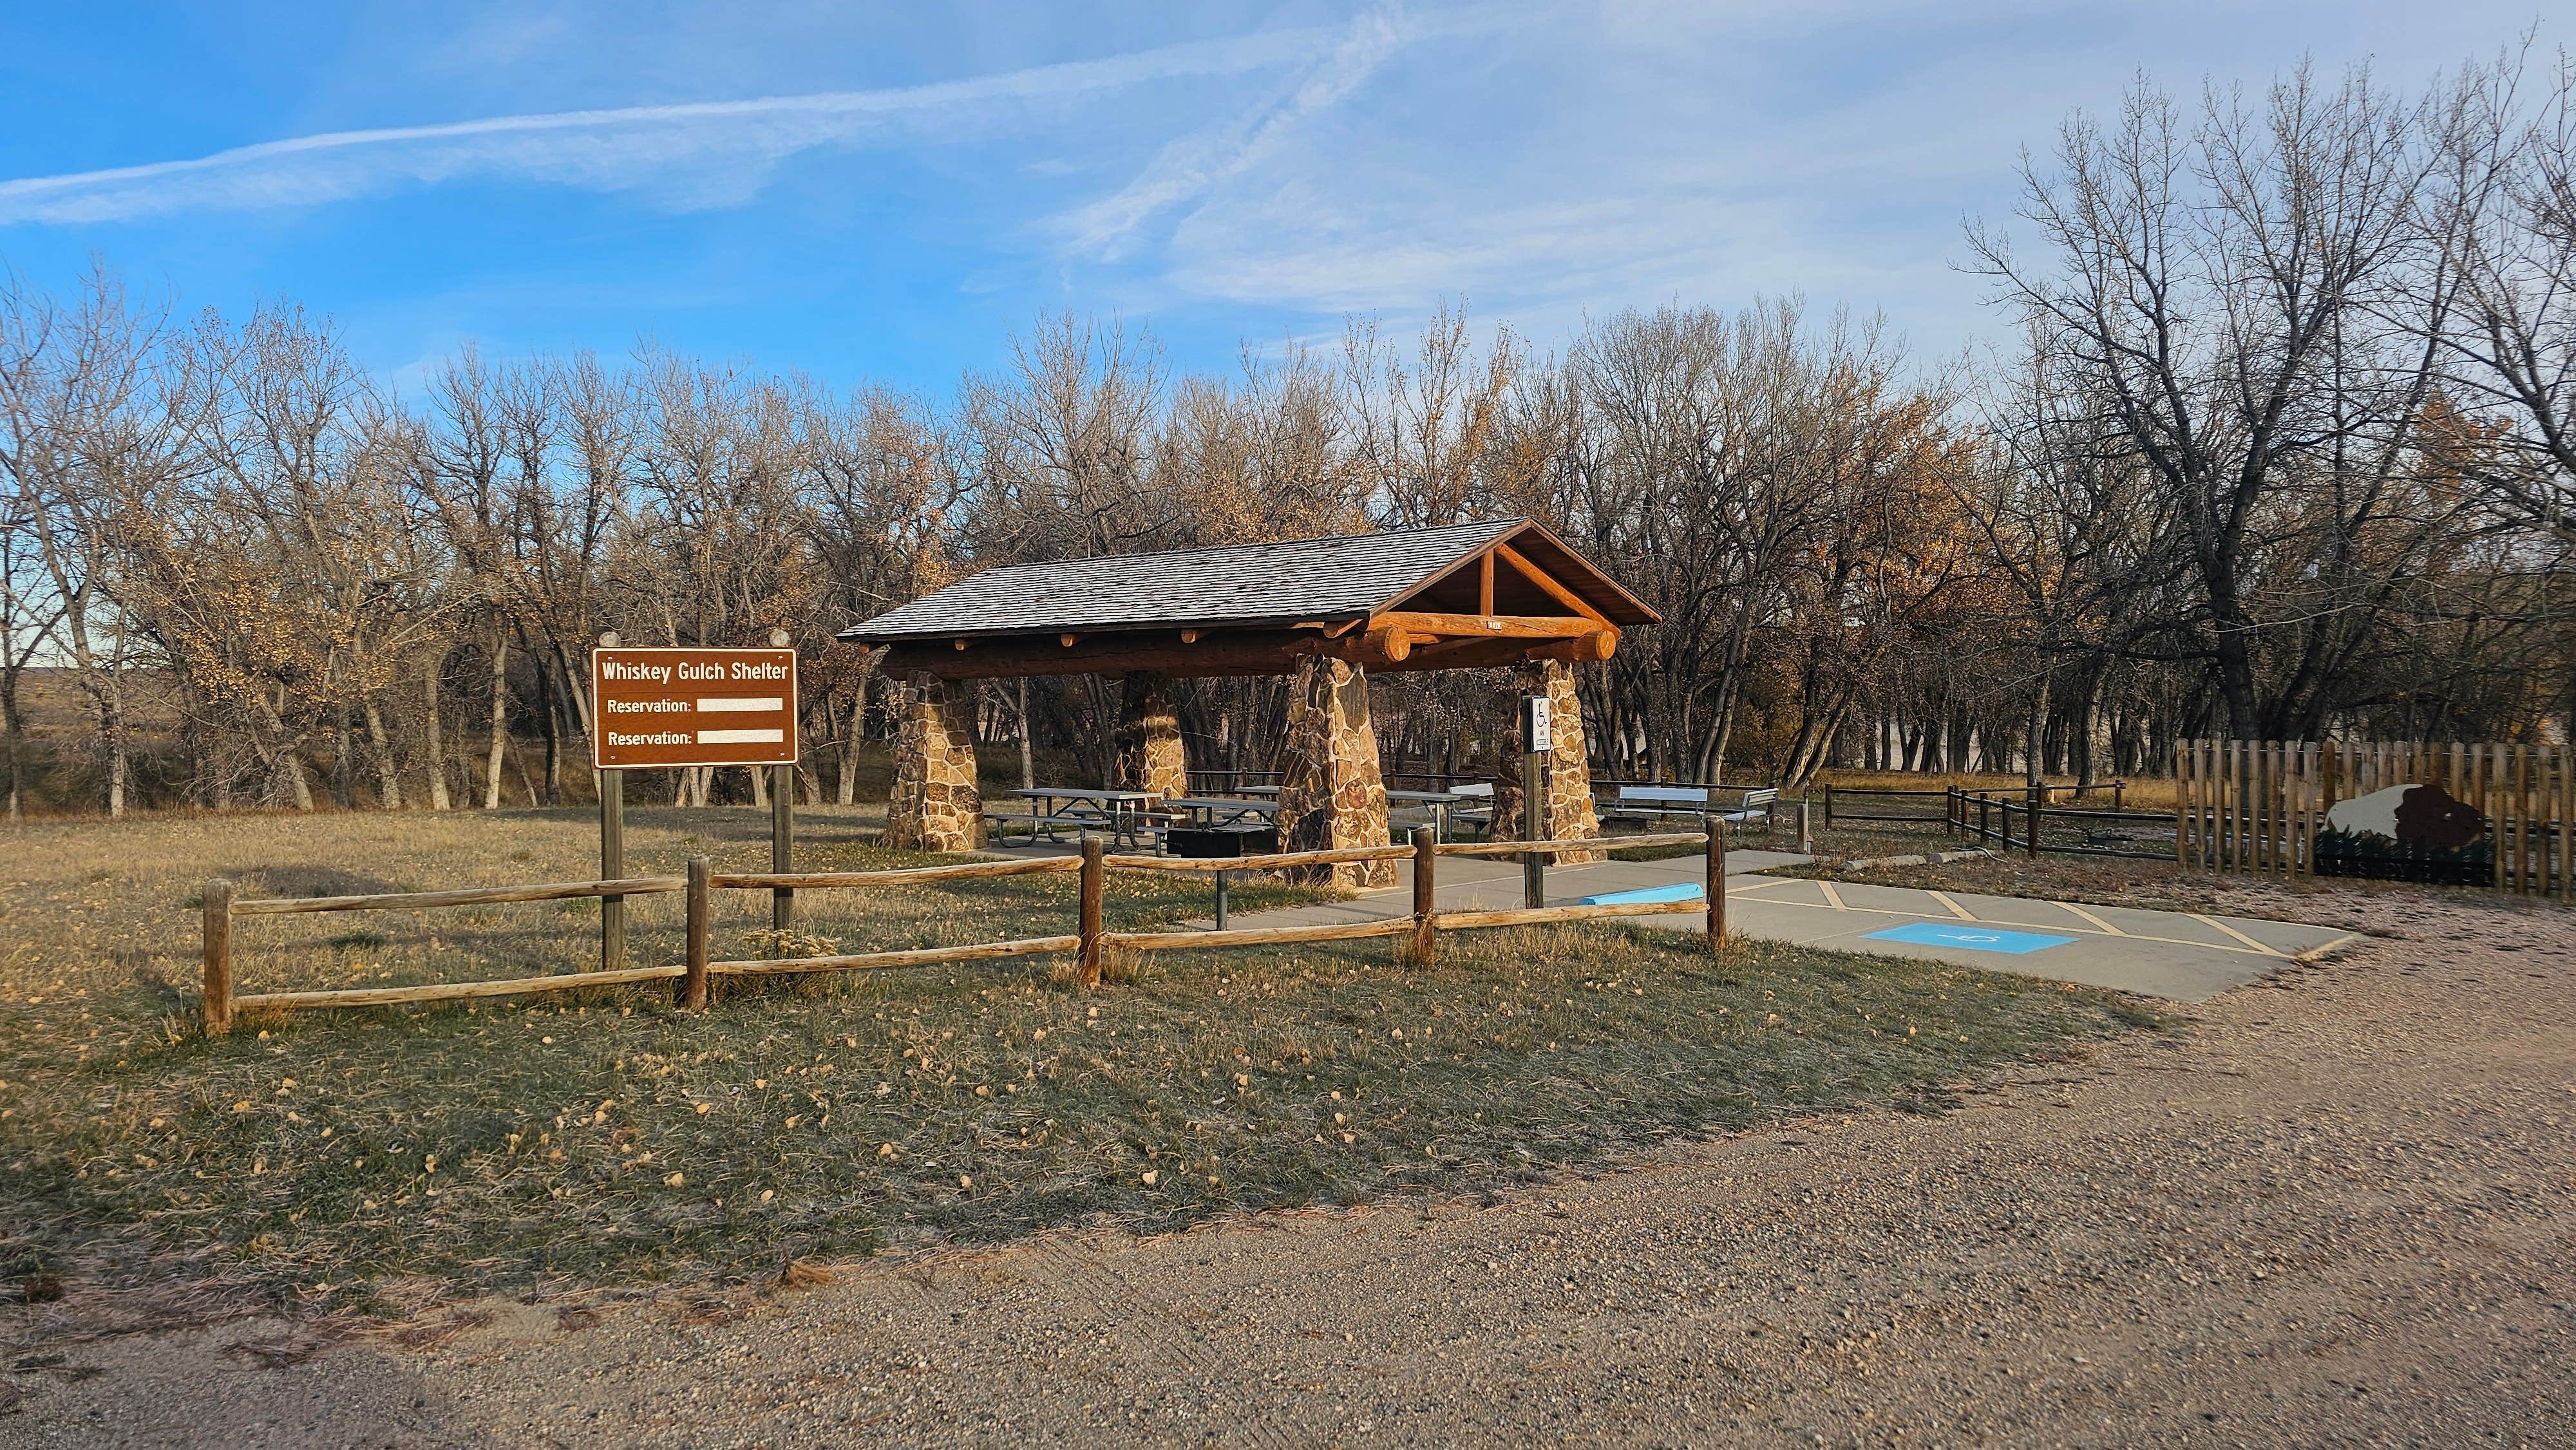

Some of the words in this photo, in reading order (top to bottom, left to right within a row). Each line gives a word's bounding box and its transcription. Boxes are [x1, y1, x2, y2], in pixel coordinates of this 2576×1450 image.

[601, 662, 671, 684] Whiskey
[678, 662, 724, 680] Gulch
[731, 662, 788, 680] Shelter
[607, 698, 692, 713] Reservation:
[608, 730, 692, 746] Reservation:
